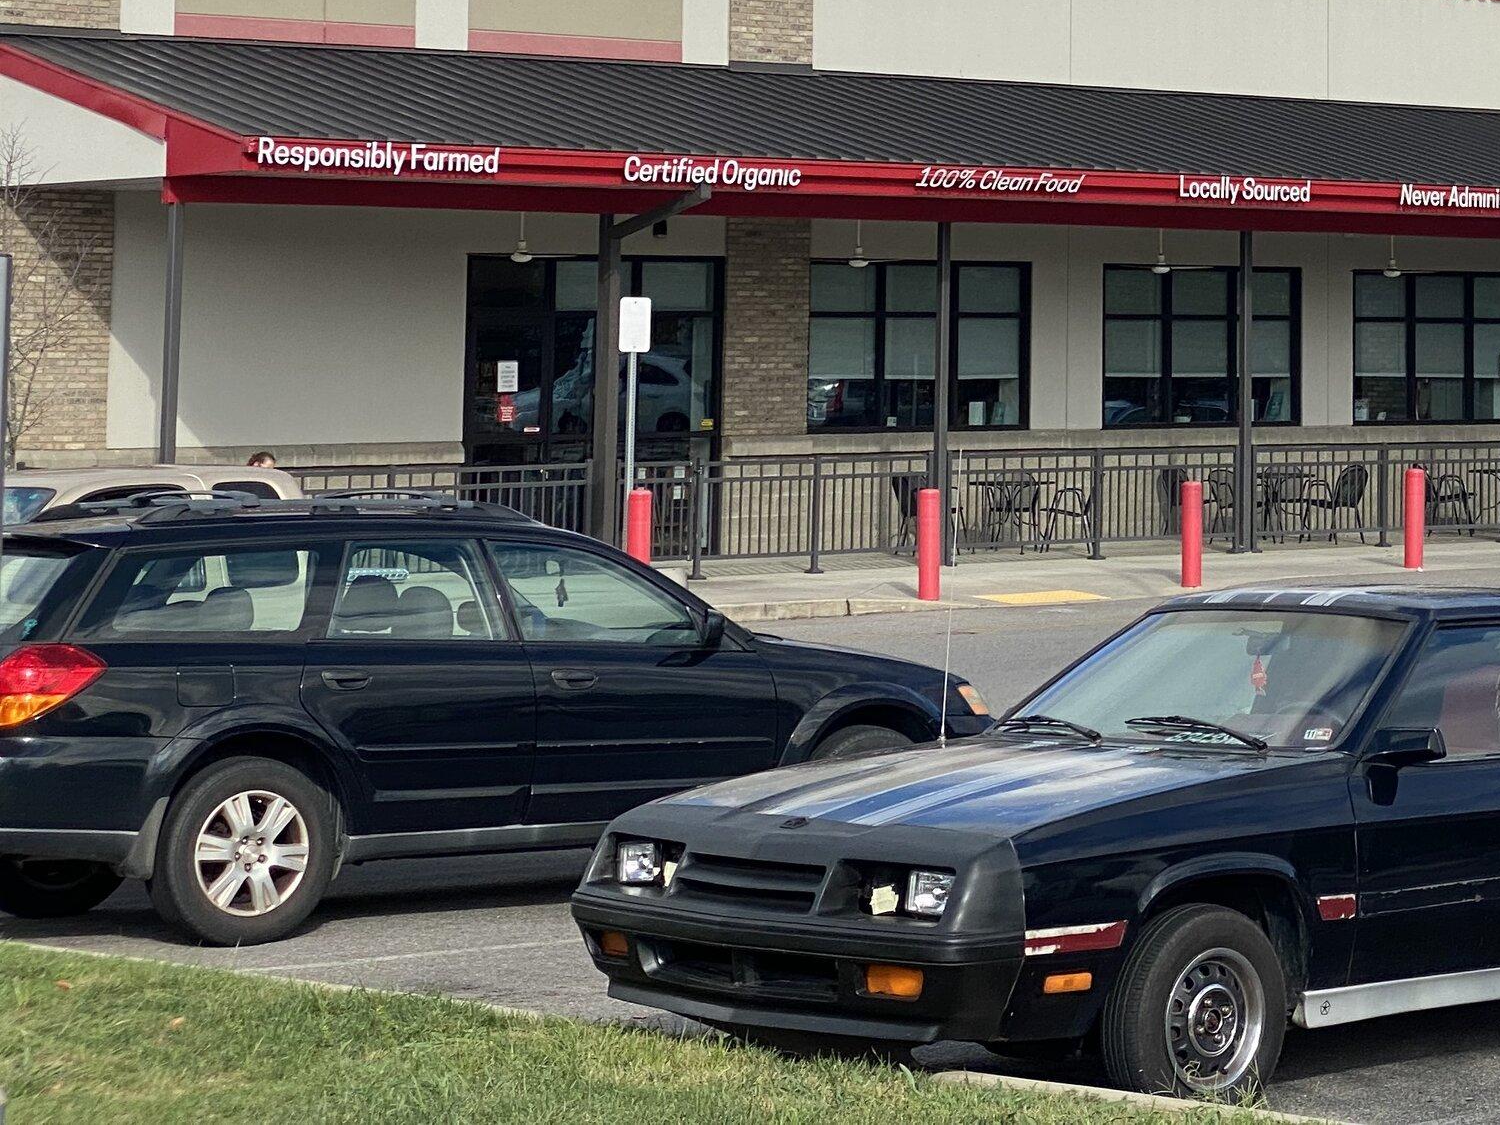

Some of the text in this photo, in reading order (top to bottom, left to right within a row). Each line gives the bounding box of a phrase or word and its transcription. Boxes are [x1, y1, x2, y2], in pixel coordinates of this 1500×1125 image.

[258, 137, 500, 176] Responsibly Farmed
[624, 156, 801, 191] Certified Organic
[915, 166, 1085, 195] 100% Clean Food
[1179, 174, 1311, 205] Locally Sourced
[1400, 183, 1446, 207] Never
